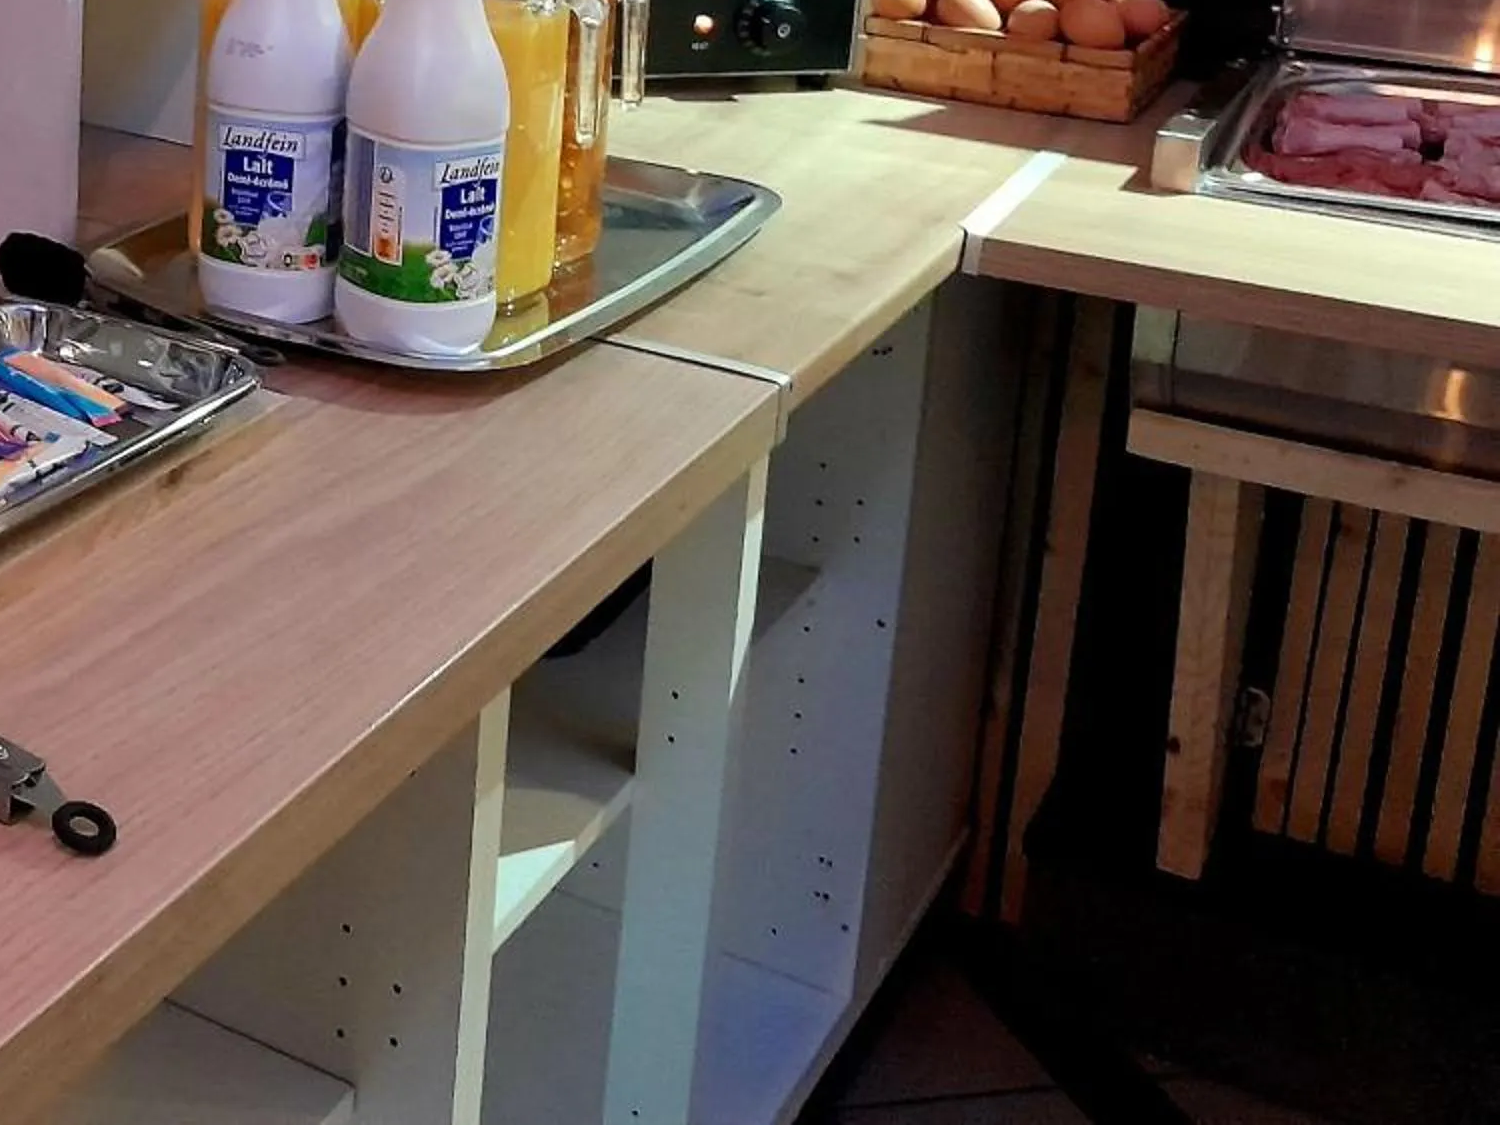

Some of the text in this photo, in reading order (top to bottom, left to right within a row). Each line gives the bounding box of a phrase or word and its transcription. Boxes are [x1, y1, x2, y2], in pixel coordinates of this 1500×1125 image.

[222, 126, 299, 158] Landfein
[243, 156, 273, 175] Lait
[461, 186, 485, 204] Lait
